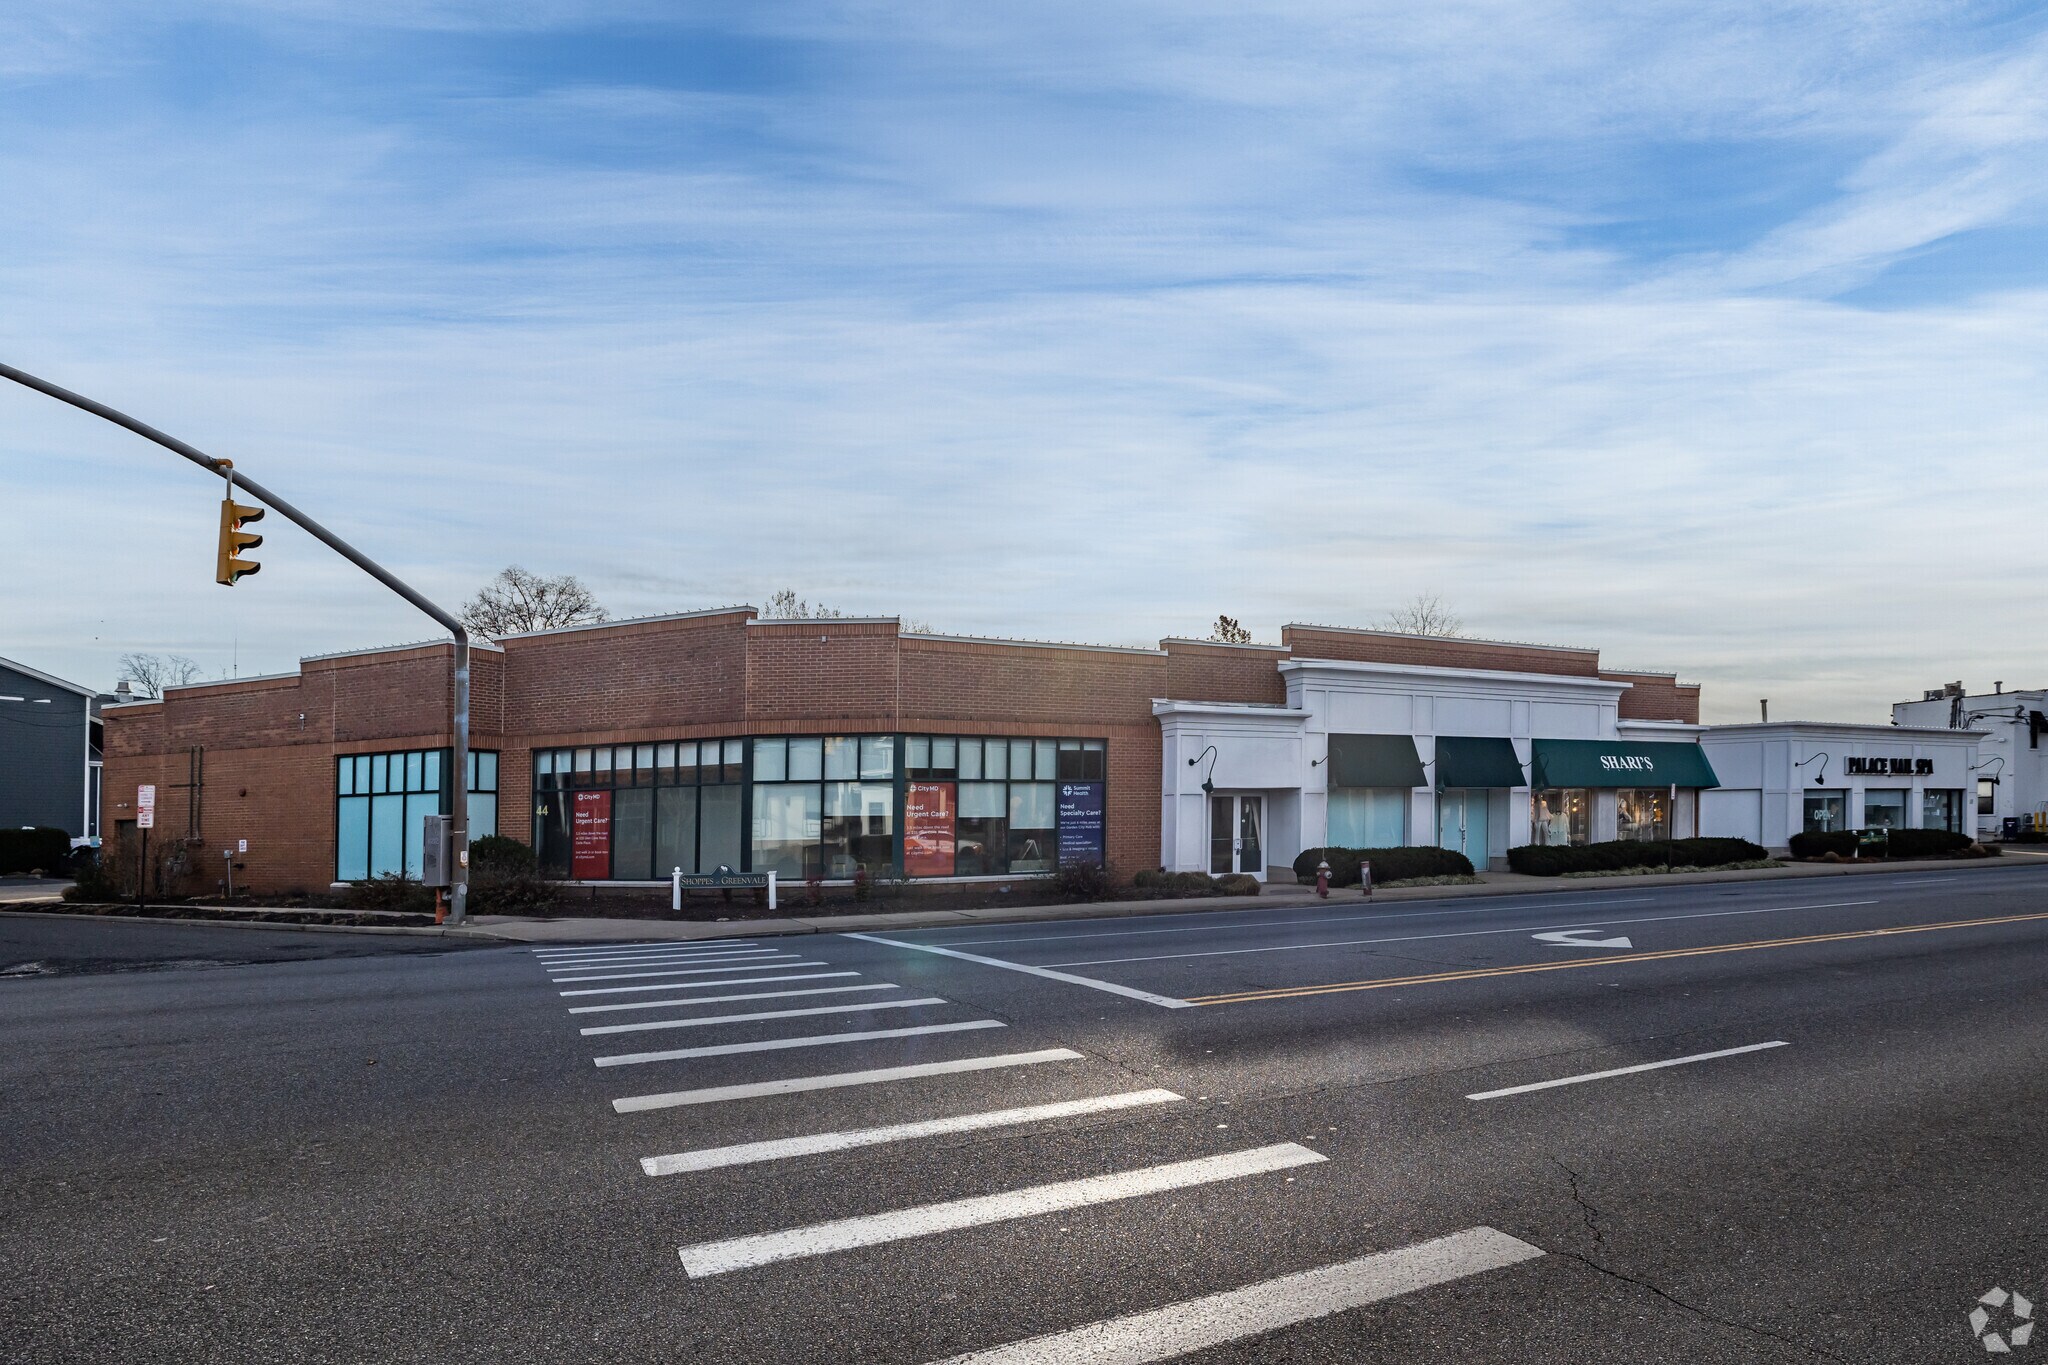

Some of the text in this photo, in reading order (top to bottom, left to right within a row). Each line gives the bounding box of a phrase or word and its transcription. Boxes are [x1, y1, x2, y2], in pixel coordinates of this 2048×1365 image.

[1600, 756, 1653, 769] SHARI'S
[1848, 758, 1934, 774] PALACE NAIL SPA
[536, 805, 548, 816] 44
[722, 876, 766, 884] GREENVALE
